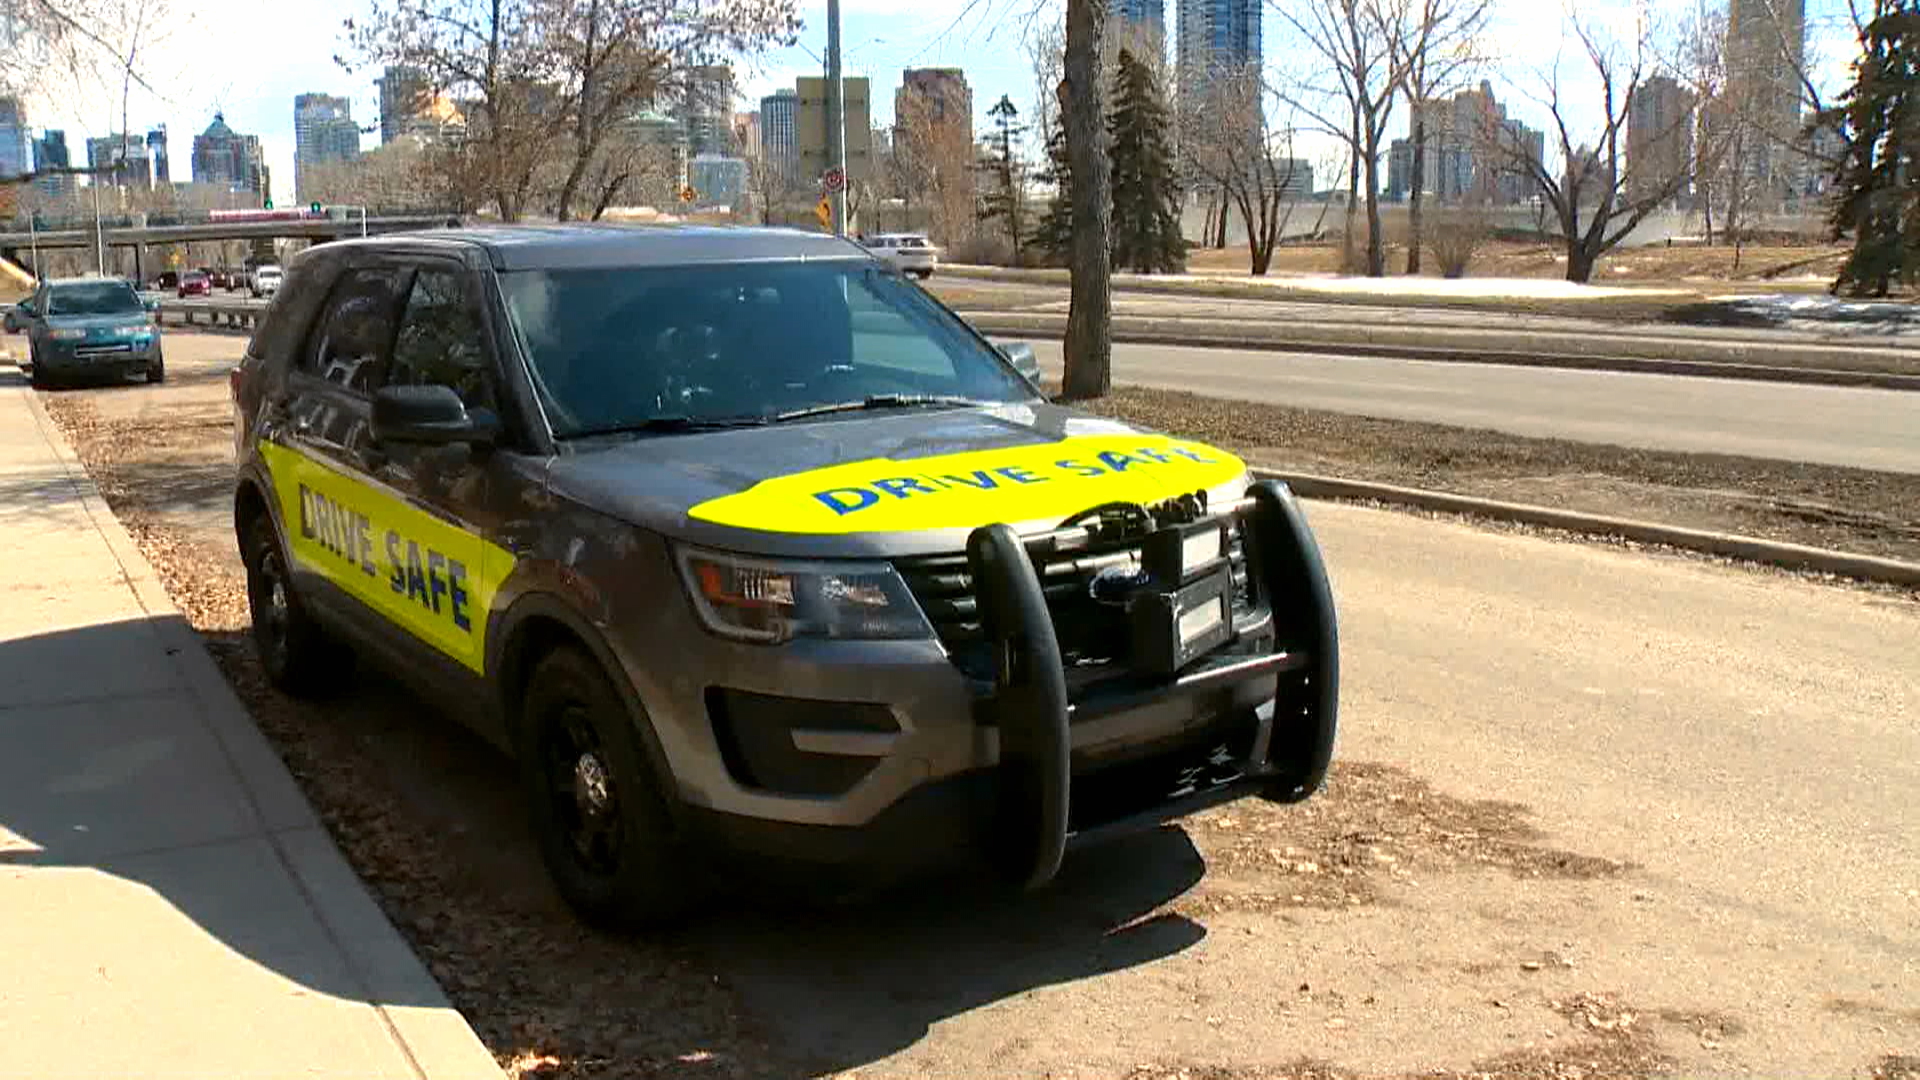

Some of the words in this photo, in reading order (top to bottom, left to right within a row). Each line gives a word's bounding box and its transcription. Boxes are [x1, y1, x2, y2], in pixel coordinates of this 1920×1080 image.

[811, 466, 1051, 516] DRIVE
[1054, 448, 1219, 477] SAFE
[299, 482, 376, 577] DRIVE
[385, 529, 472, 633] SAFE
